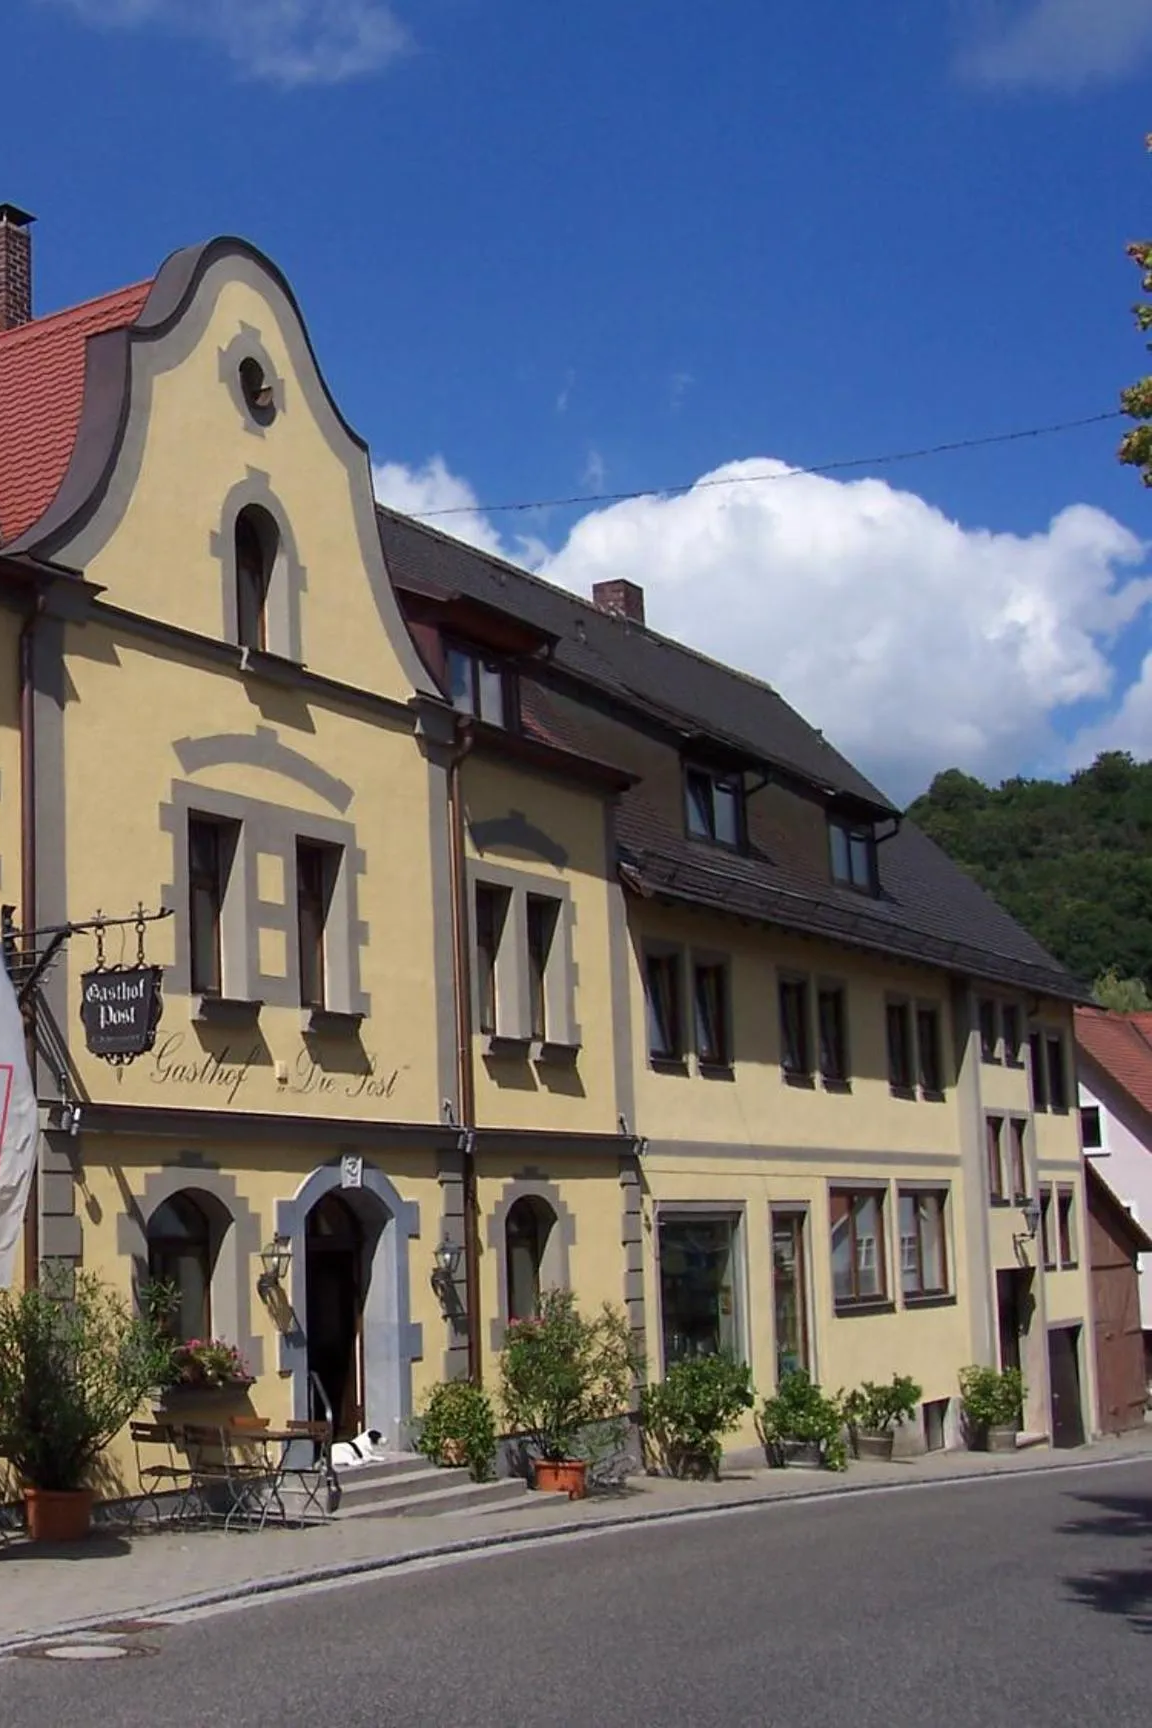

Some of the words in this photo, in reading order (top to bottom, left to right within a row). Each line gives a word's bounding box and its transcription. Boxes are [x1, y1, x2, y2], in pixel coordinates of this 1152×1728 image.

[85, 978, 145, 1003] Gasthof
[99, 1004, 135, 1030] Post
[149, 1030, 261, 1105] Gasthof
